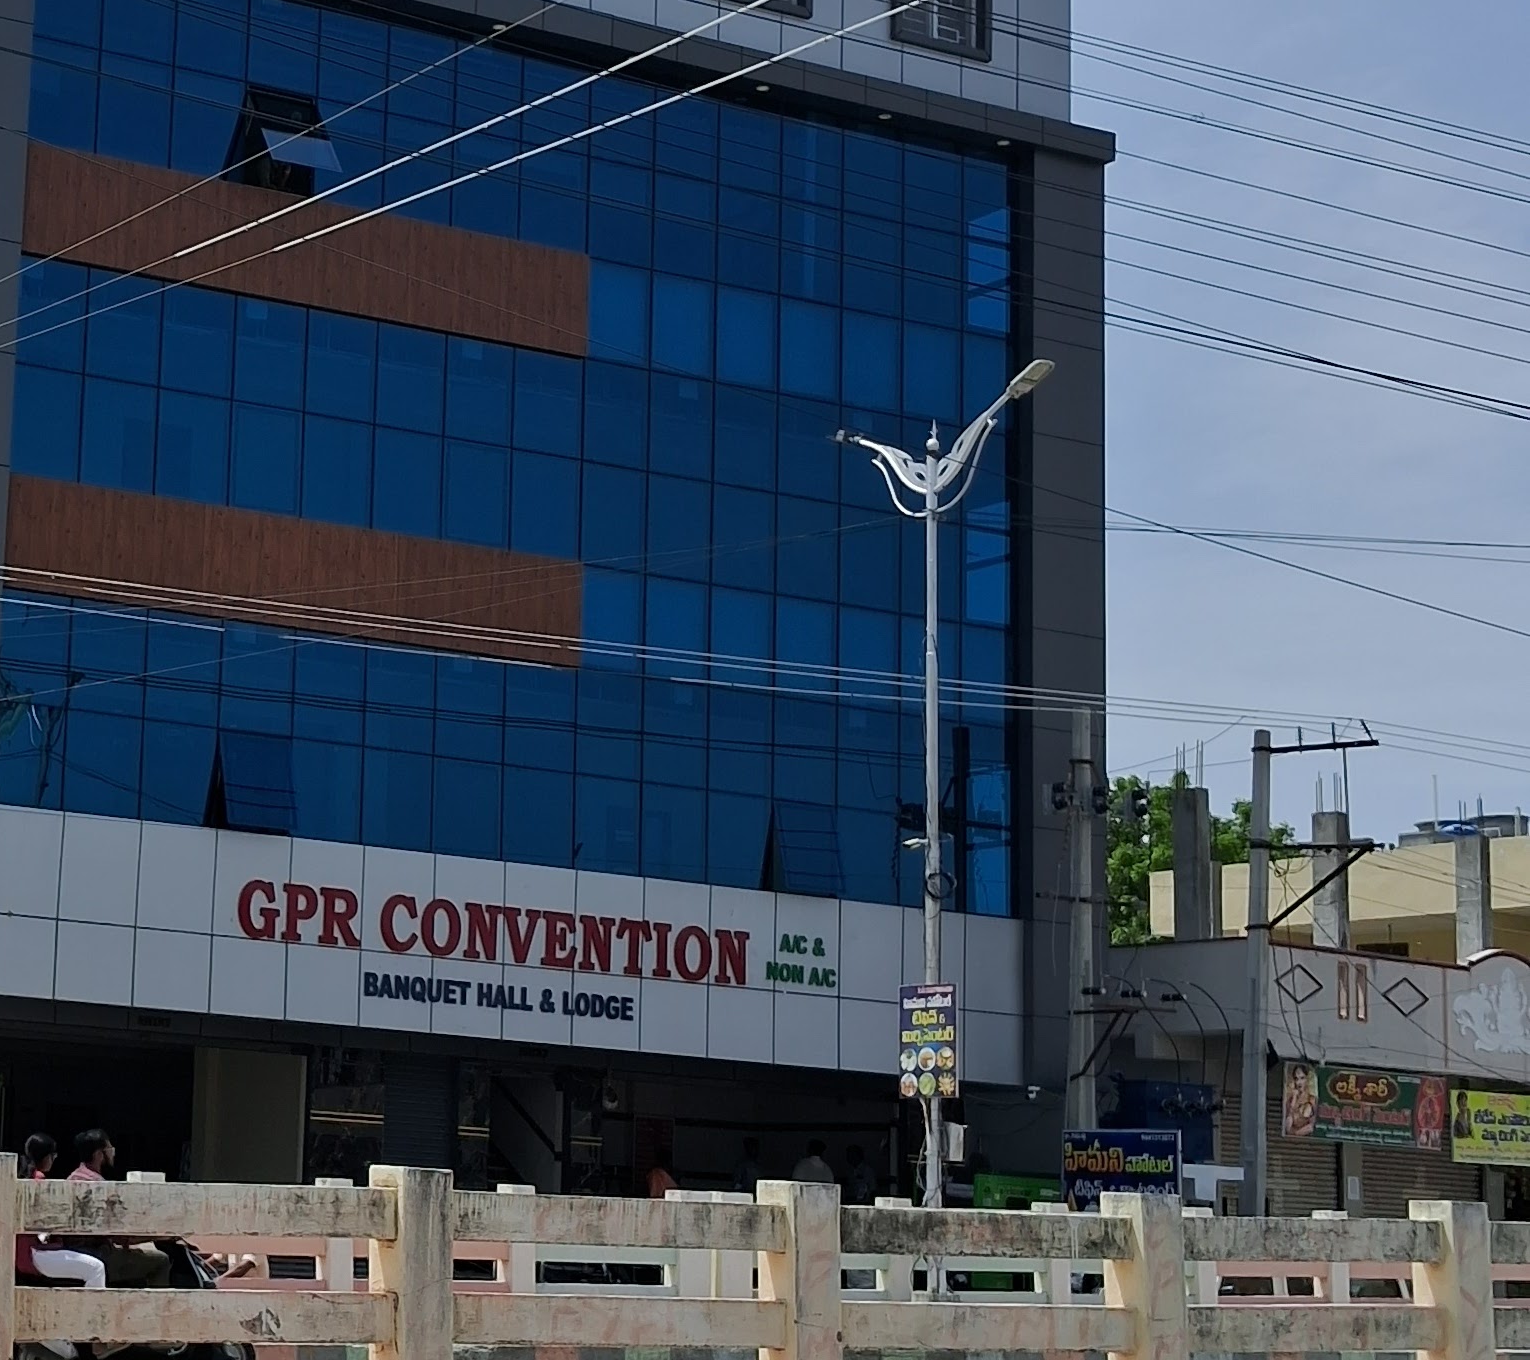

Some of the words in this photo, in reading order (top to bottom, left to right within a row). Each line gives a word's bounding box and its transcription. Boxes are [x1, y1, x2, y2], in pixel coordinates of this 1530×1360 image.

[237, 879, 361, 947] GPR
[380, 894, 750, 986] CONVENTION
[779, 934, 807, 955] A/C
[812, 937, 826, 957] &
[766, 961, 804, 985] NON
[808, 966, 837, 988] A/C
[363, 971, 471, 1005] BANQUET
[477, 982, 533, 1012] HALL
[539, 988, 555, 1013] &
[562, 991, 634, 1021] LODGE
